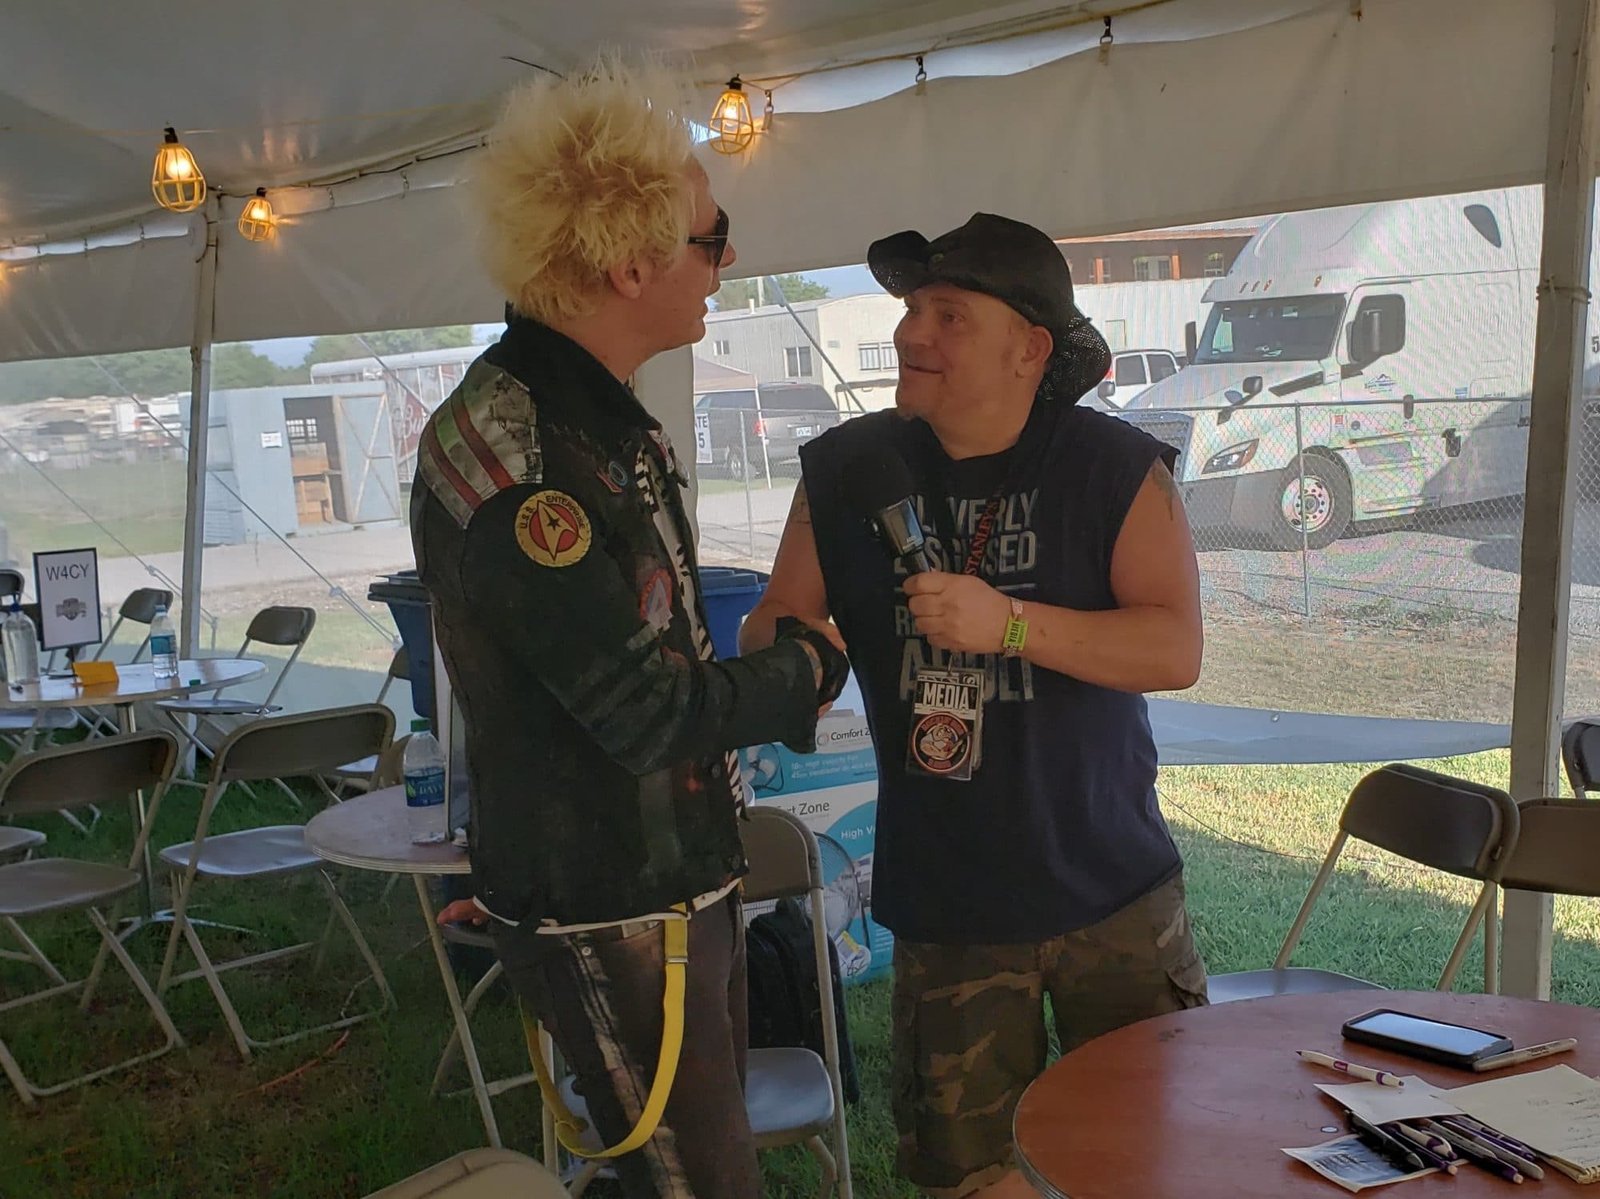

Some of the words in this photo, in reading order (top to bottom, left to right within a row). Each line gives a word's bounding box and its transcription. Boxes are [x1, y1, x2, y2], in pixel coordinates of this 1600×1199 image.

[698, 432, 706, 449] 5
[45, 564, 89, 581] W4CY
[922, 682, 970, 711] MEDIA
[831, 728, 864, 741] Comfort
[799, 802, 830, 816] Zone
[841, 828, 864, 840] High
